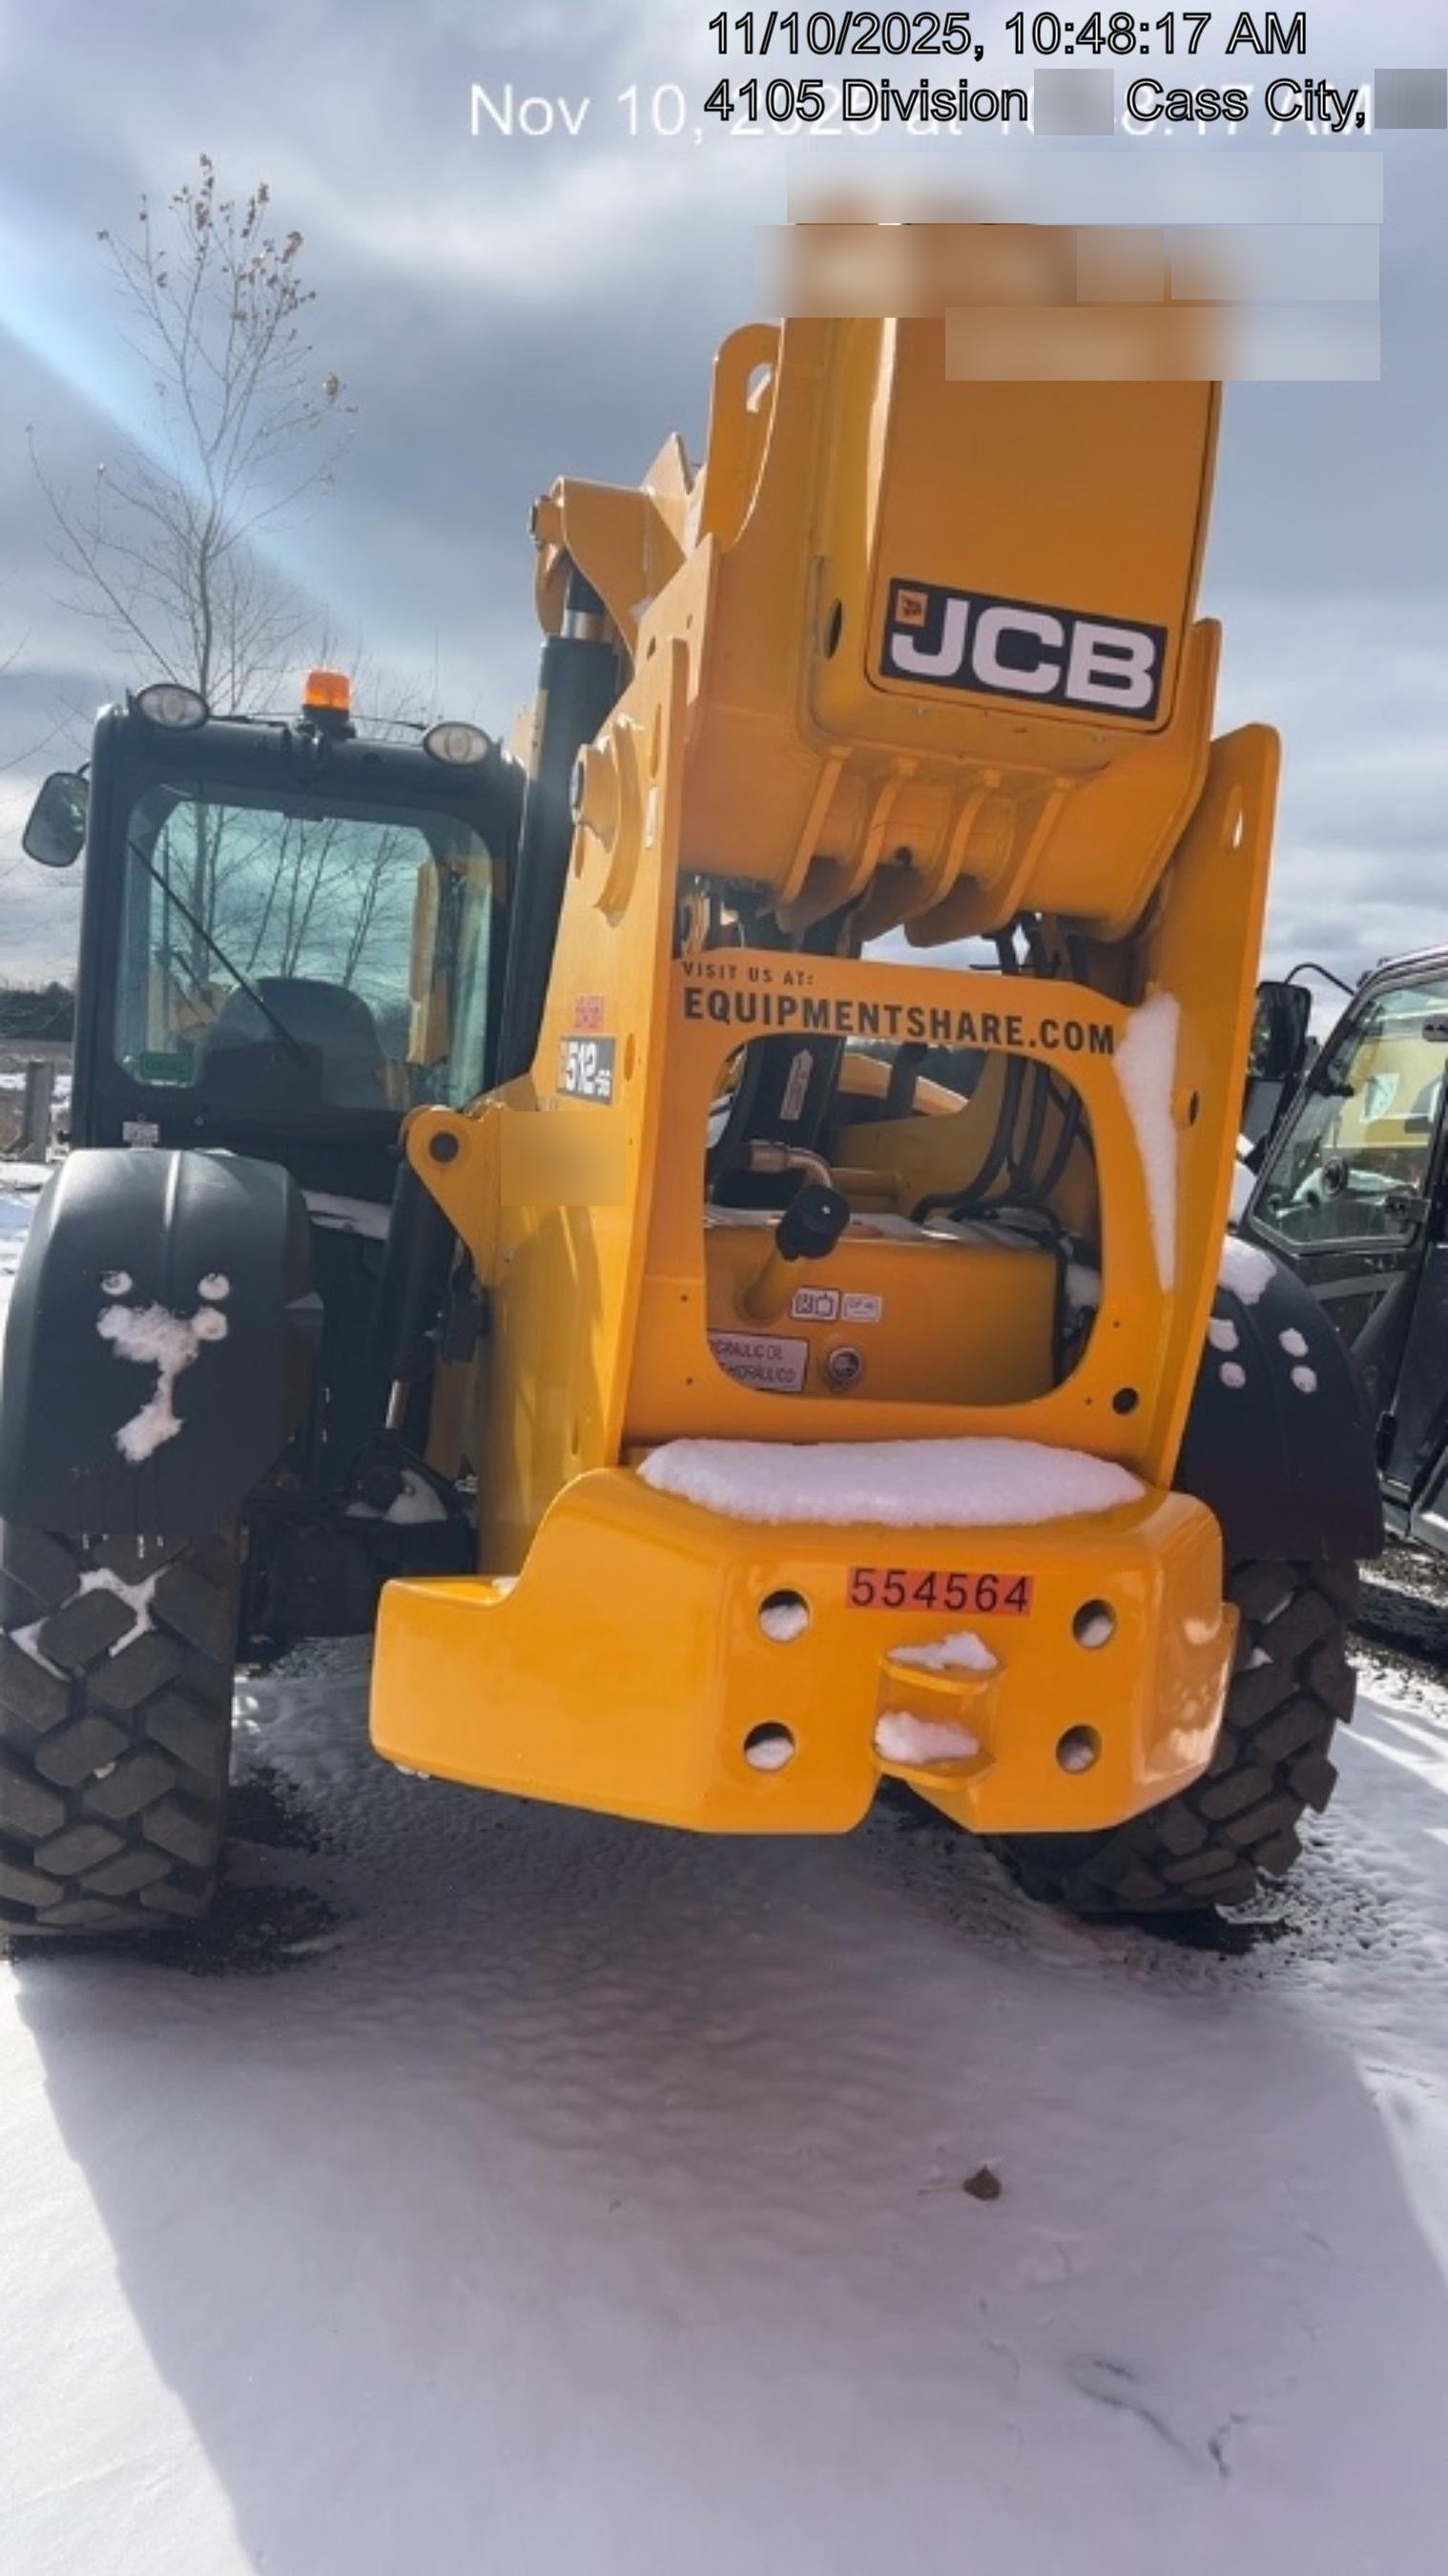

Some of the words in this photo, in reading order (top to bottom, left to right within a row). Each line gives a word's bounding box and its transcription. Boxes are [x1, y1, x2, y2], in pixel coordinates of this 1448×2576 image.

[891, 597, 1155, 709] JCB
[681, 961, 736, 982] VISIT
[748, 967, 774, 983] US
[783, 970, 814, 986] AT:
[684, 987, 1114, 1054] EQUIPMENTSHARE.COM
[852, 1568, 1028, 1612] 554564
